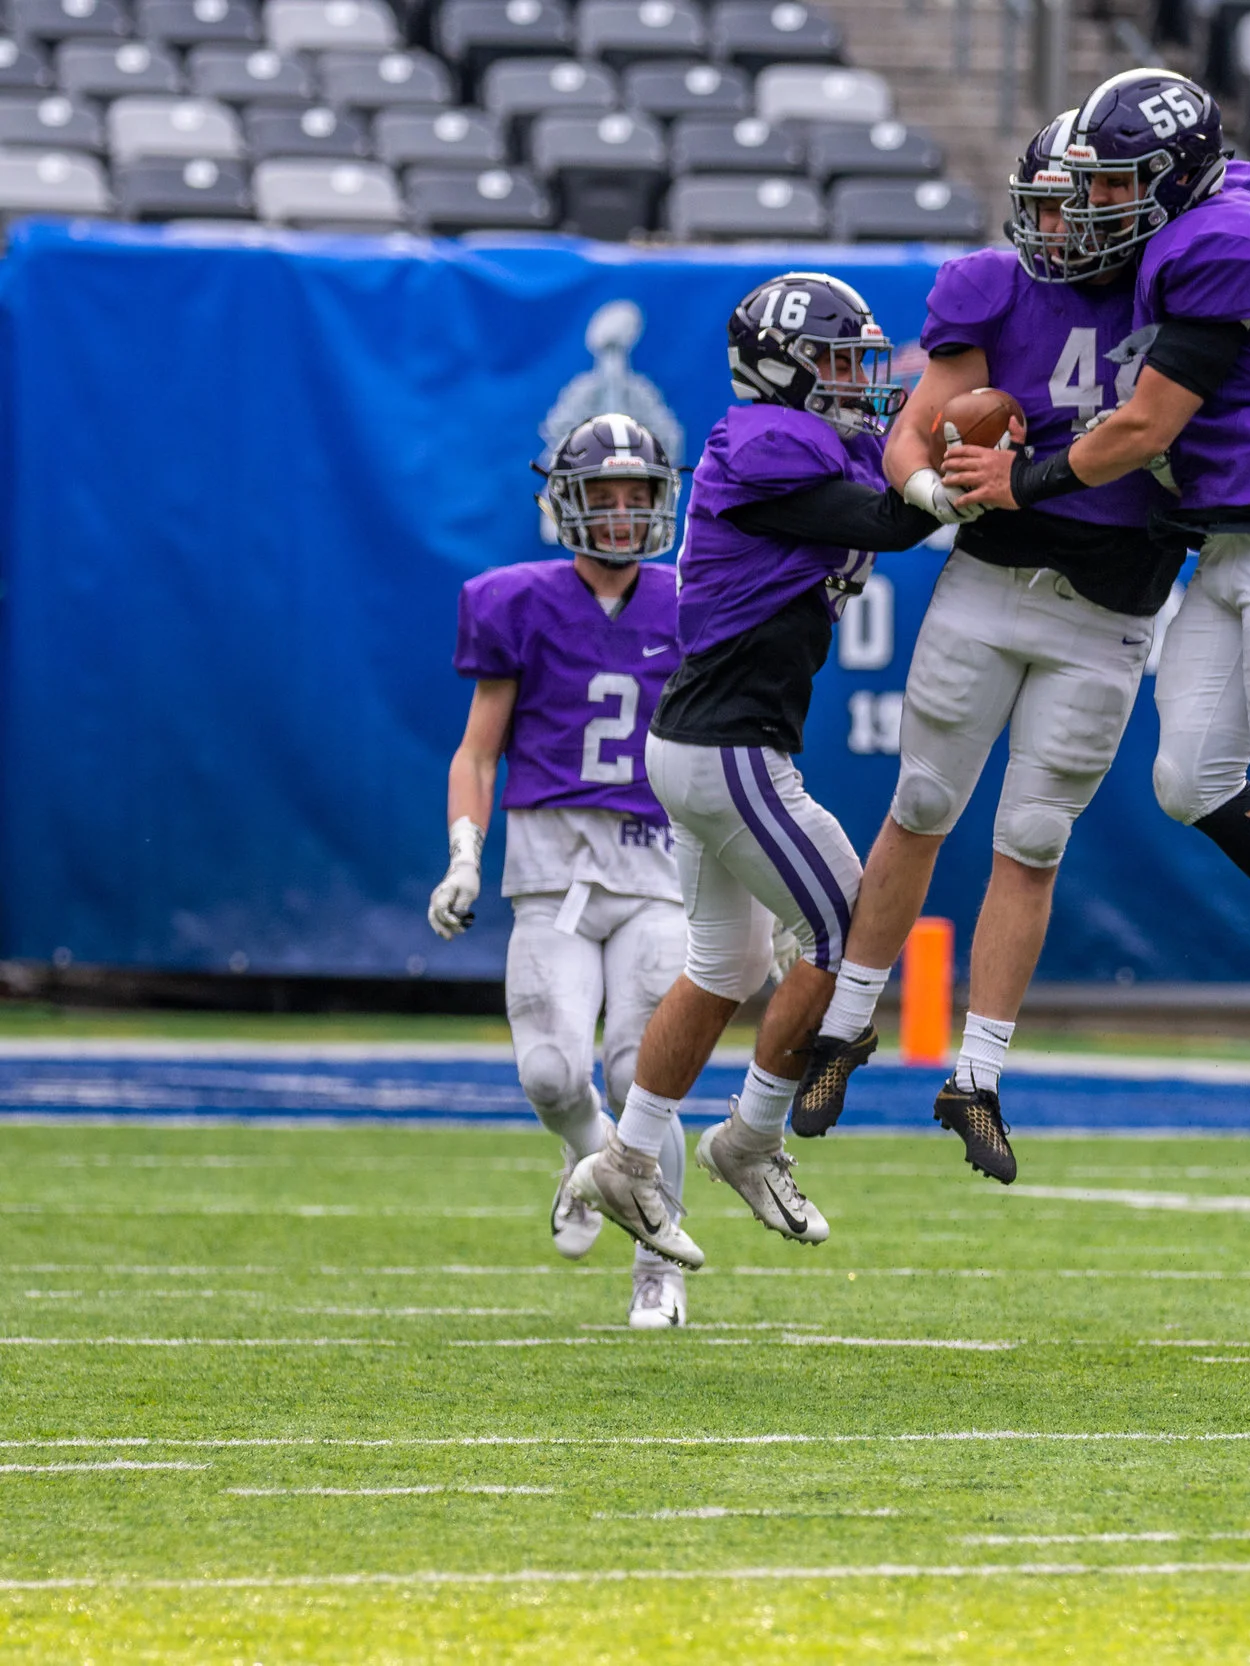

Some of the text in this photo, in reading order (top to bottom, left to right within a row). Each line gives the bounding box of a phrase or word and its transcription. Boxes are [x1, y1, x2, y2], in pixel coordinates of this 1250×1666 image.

[1138, 86, 1199, 140] 55
[759, 289, 812, 330] 16
[580, 672, 641, 785] 2
